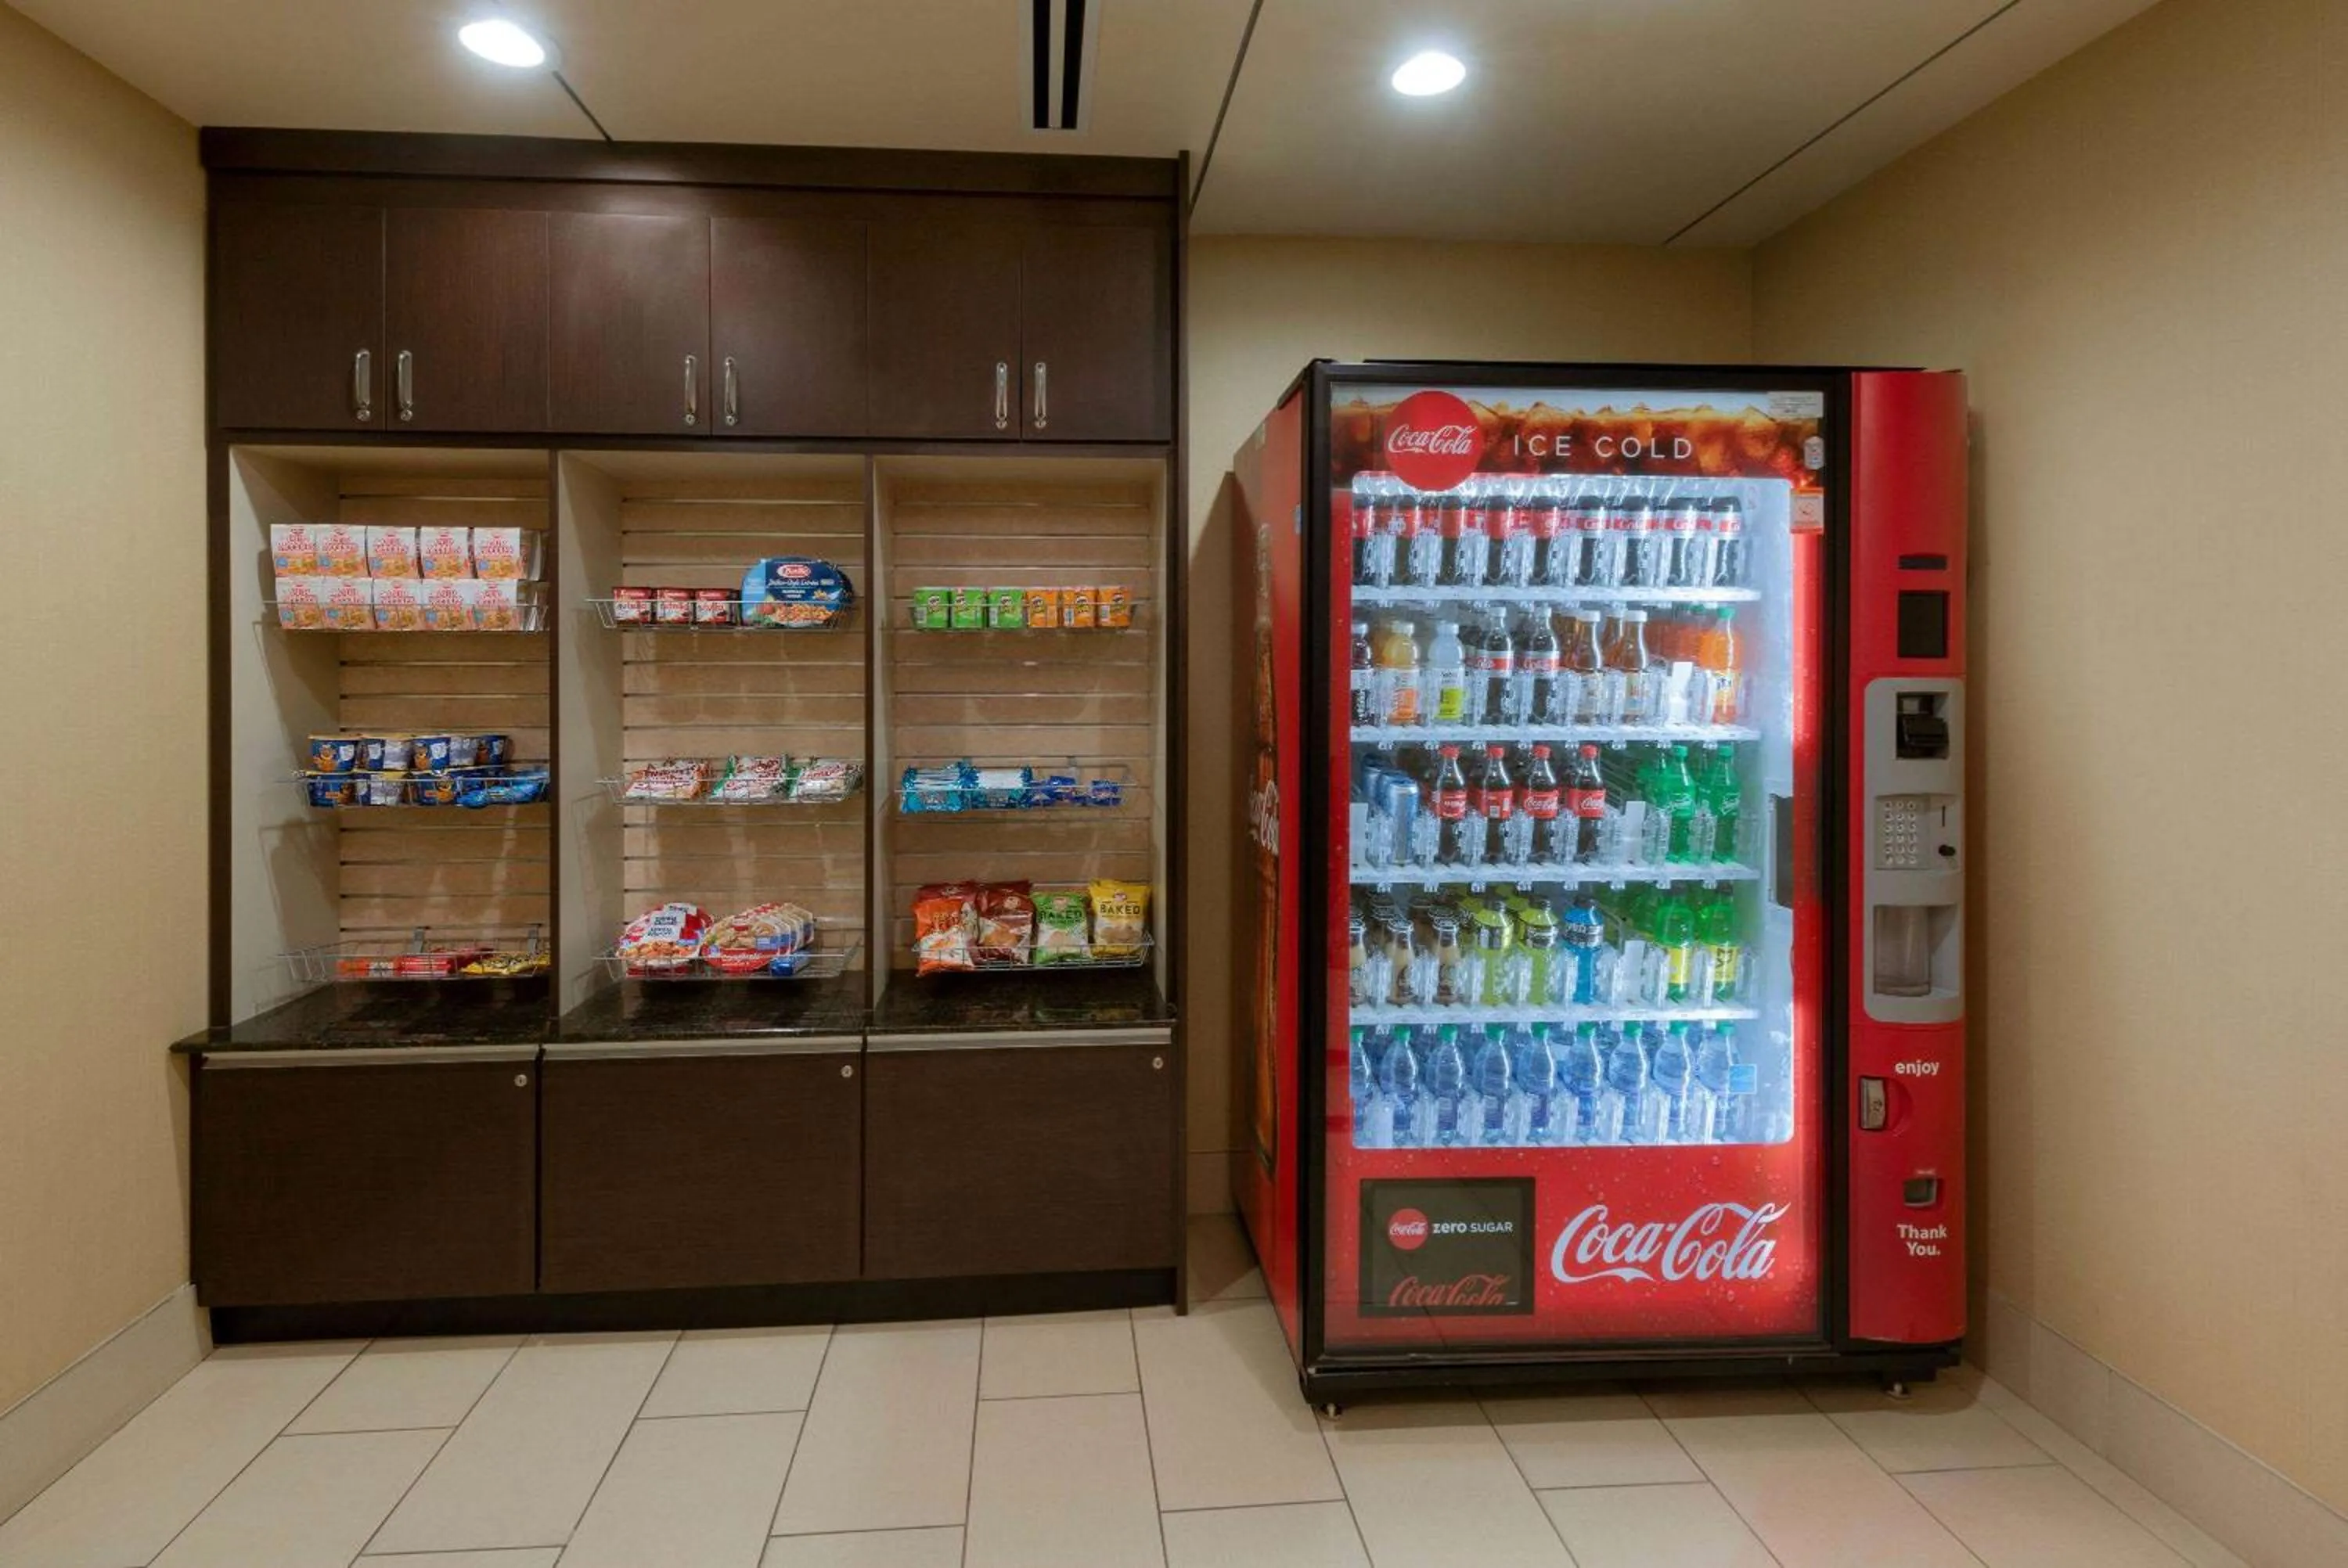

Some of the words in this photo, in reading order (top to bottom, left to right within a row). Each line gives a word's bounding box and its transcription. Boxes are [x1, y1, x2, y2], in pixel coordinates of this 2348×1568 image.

[1388, 424, 1478, 455] Coca-Cola
[1514, 435, 1572, 457] ICE
[1595, 437, 1692, 460] COLD
[1039, 909, 1082, 920] BAKED
[1100, 904, 1140, 915] BAKED
[1895, 1059, 1939, 1077] enjoy
[1432, 1222, 1468, 1234] zero
[1471, 1221, 1514, 1233] SUGAR
[1896, 1224, 1948, 1239] Thank
[1551, 1201, 1792, 1283] Coca-Cola
[1906, 1242, 1941, 1257] You.
